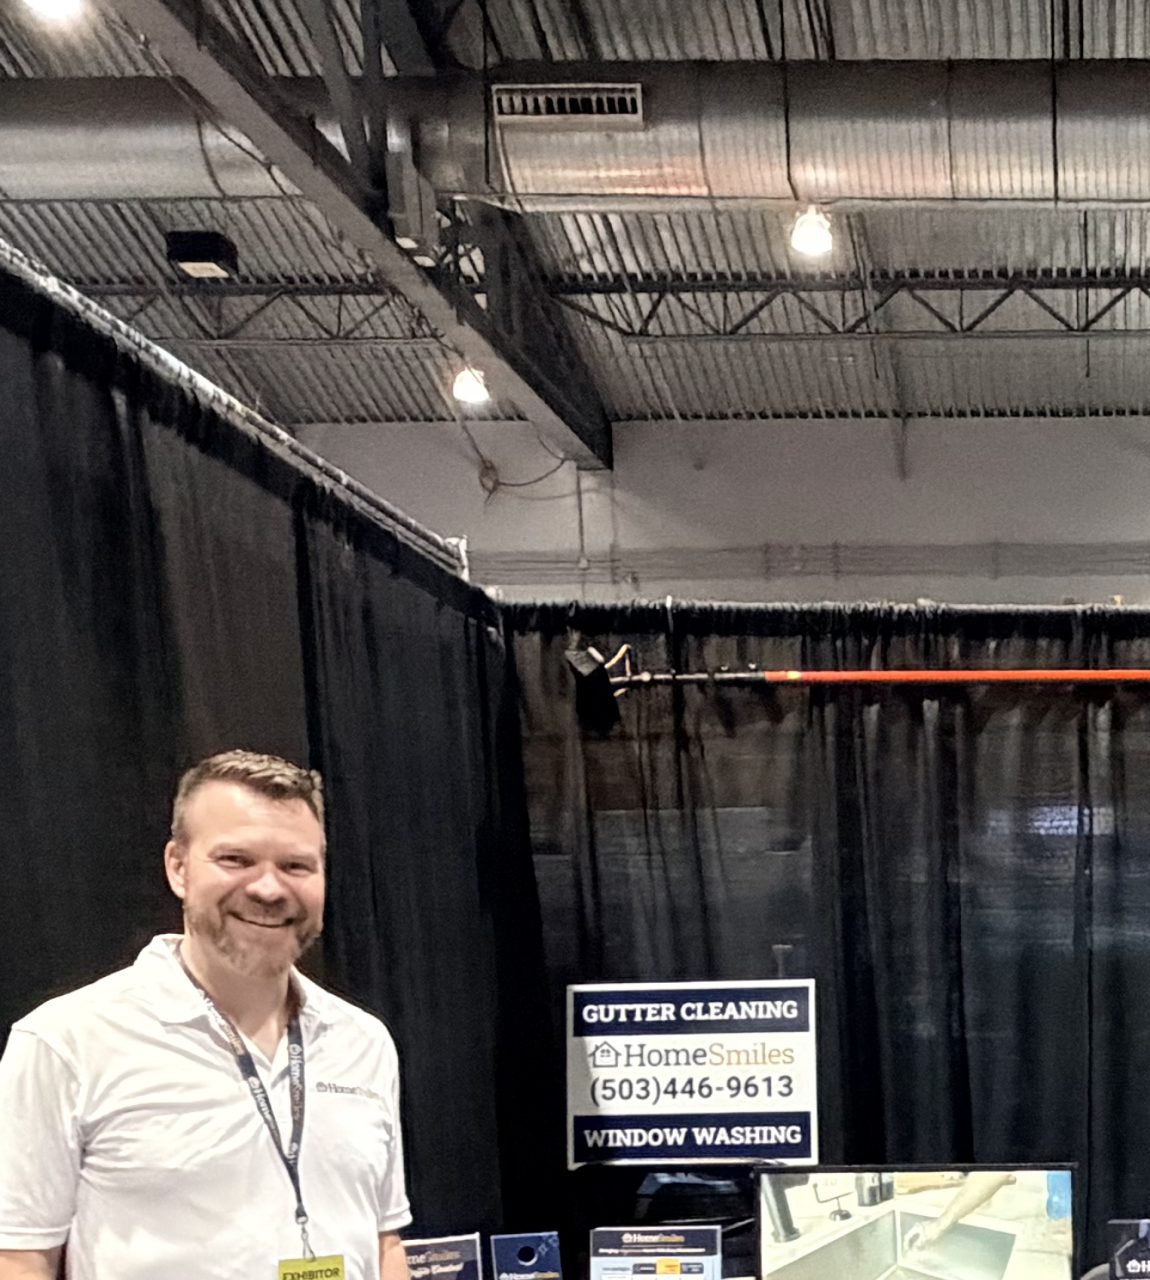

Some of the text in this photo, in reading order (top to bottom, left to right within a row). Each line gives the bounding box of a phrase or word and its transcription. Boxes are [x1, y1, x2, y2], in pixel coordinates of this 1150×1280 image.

[582, 1000, 799, 1023] GUTTER CLEANING
[624, 1042, 795, 1067] HomeSmiles
[590, 1075, 794, 1107] (503)446-9613
[584, 1126, 802, 1148] WINDOW WASHING
